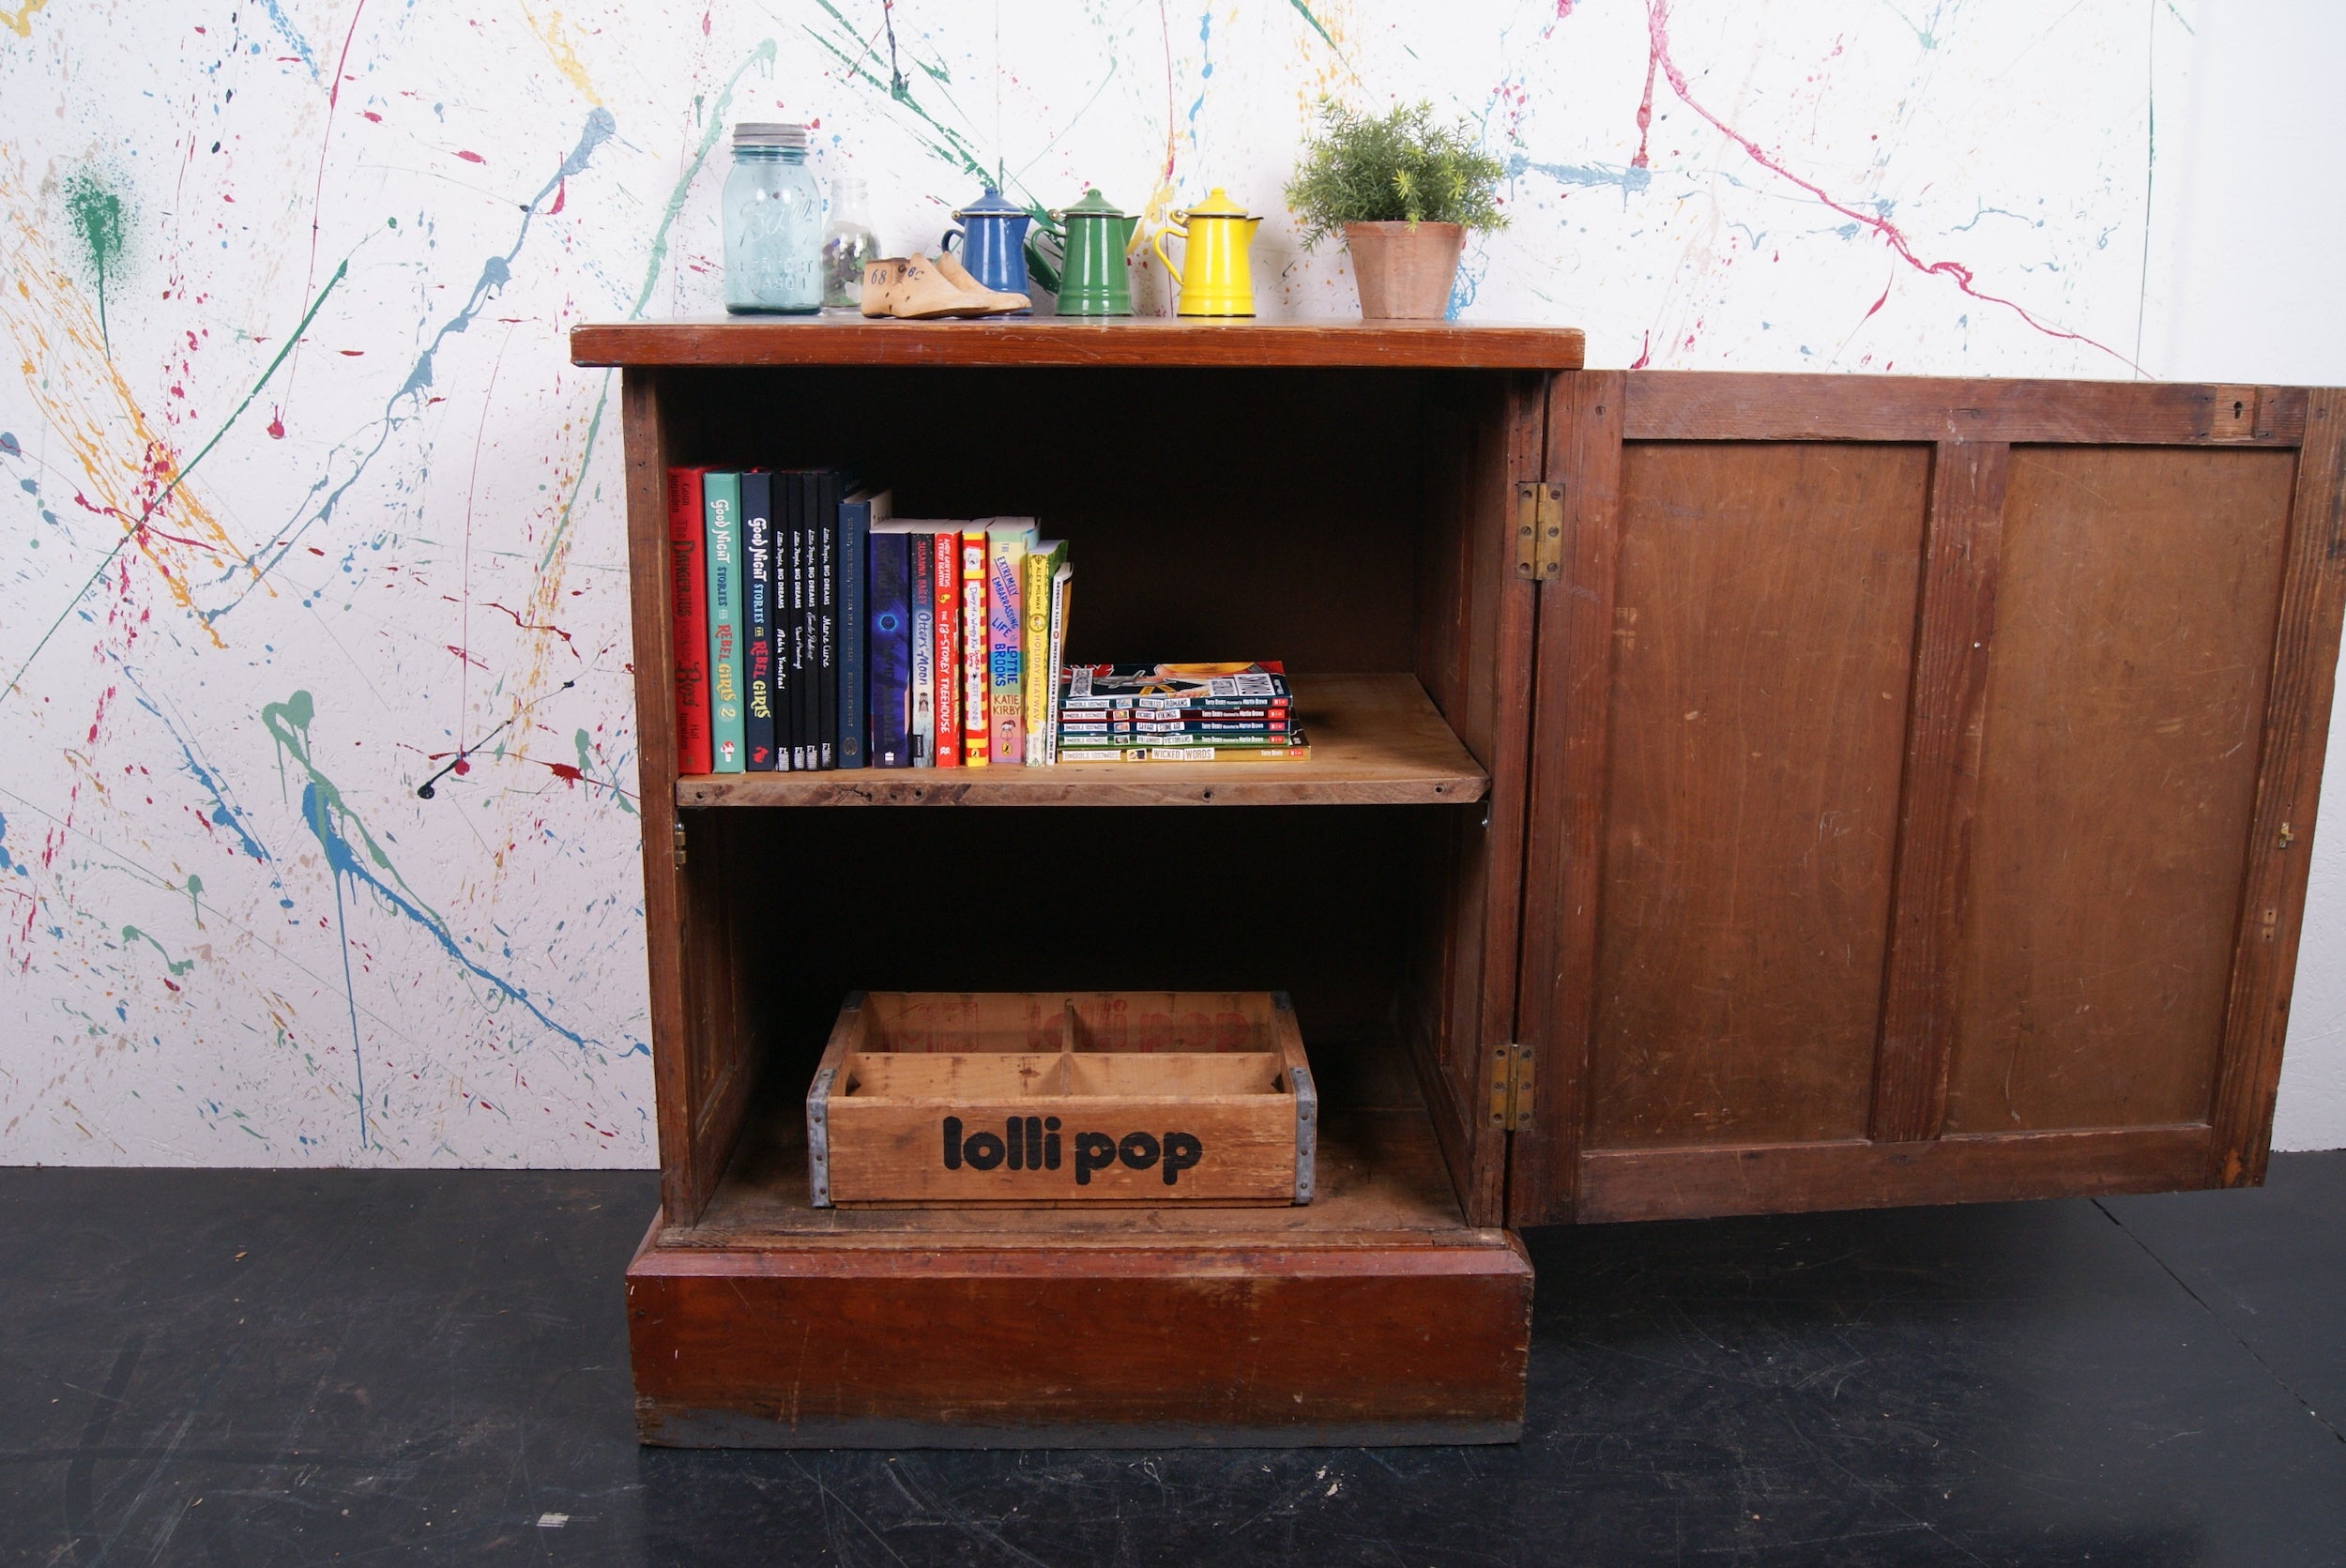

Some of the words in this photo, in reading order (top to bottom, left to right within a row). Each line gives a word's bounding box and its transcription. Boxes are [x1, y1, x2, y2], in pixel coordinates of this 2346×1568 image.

[871, 268, 887, 285] 68
[916, 540, 927, 577] SUSANNA
[1000, 542, 1010, 553] THE
[717, 567, 728, 607] STORIES
[997, 556, 1020, 597] EXTREMELY
[754, 584, 765, 624] STORIES
[777, 581, 785, 609] DREAMS
[969, 586, 978, 605] Diary
[991, 576, 1019, 630] EMBARRASSING
[822, 615, 831, 644] Marie
[991, 617, 1013, 637] LIFE
[713, 624, 734, 662] REBEL
[822, 645, 831, 668] Curie
[939, 623, 951, 675] 13-STOREY
[970, 638, 979, 649] Kid
[751, 640, 769, 678] REBEL
[916, 650, 929, 686] Moon
[995, 643, 1007, 687] BROOKS
[1007, 646, 1018, 684] LOTTIE
[720, 708, 737, 718] 2
[939, 677, 951, 734] TREEHOUSE
[993, 706, 1021, 715] KIRBY
[994, 694, 1020, 705] KATIE
[1032, 677, 1041, 725] HEATWAVE
[1165, 699, 1188, 708] ROMANS
[1157, 710, 1177, 719] VIKINGS
[690, 724, 700, 739] Hal
[1153, 750, 1181, 759] WICKED
[1185, 749, 1211, 759] WORDS
[943, 1116, 1061, 1171] lolli
[1074, 1132, 1203, 1186] pop
